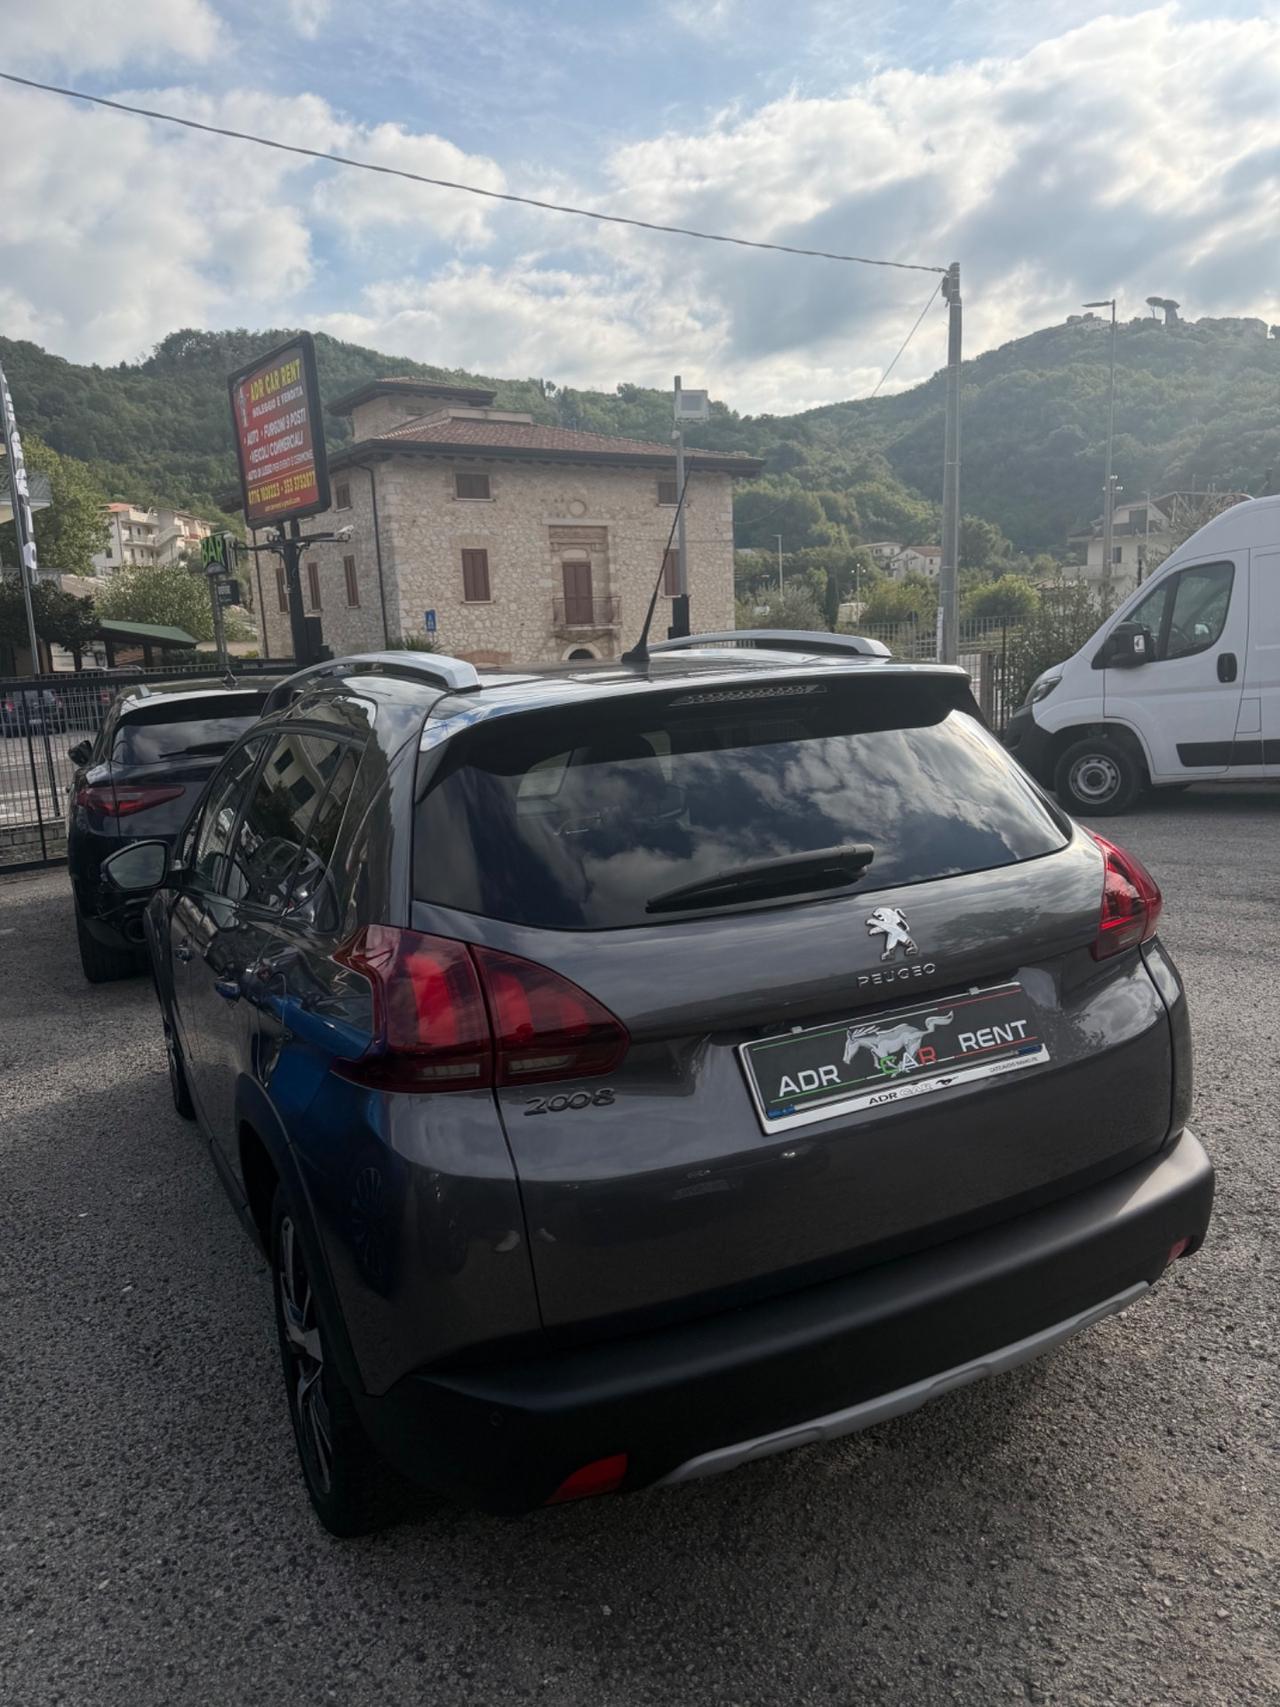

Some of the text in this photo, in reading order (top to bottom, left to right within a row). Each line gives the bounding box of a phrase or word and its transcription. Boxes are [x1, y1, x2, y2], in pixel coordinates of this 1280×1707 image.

[251, 358, 301, 401] ADR CAR RENT
[202, 534, 226, 569] BAR
[778, 1019, 1027, 1098] ADR CAR RENT
[523, 1087, 616, 1117] 2008
[868, 1091, 899, 1105] ADR
